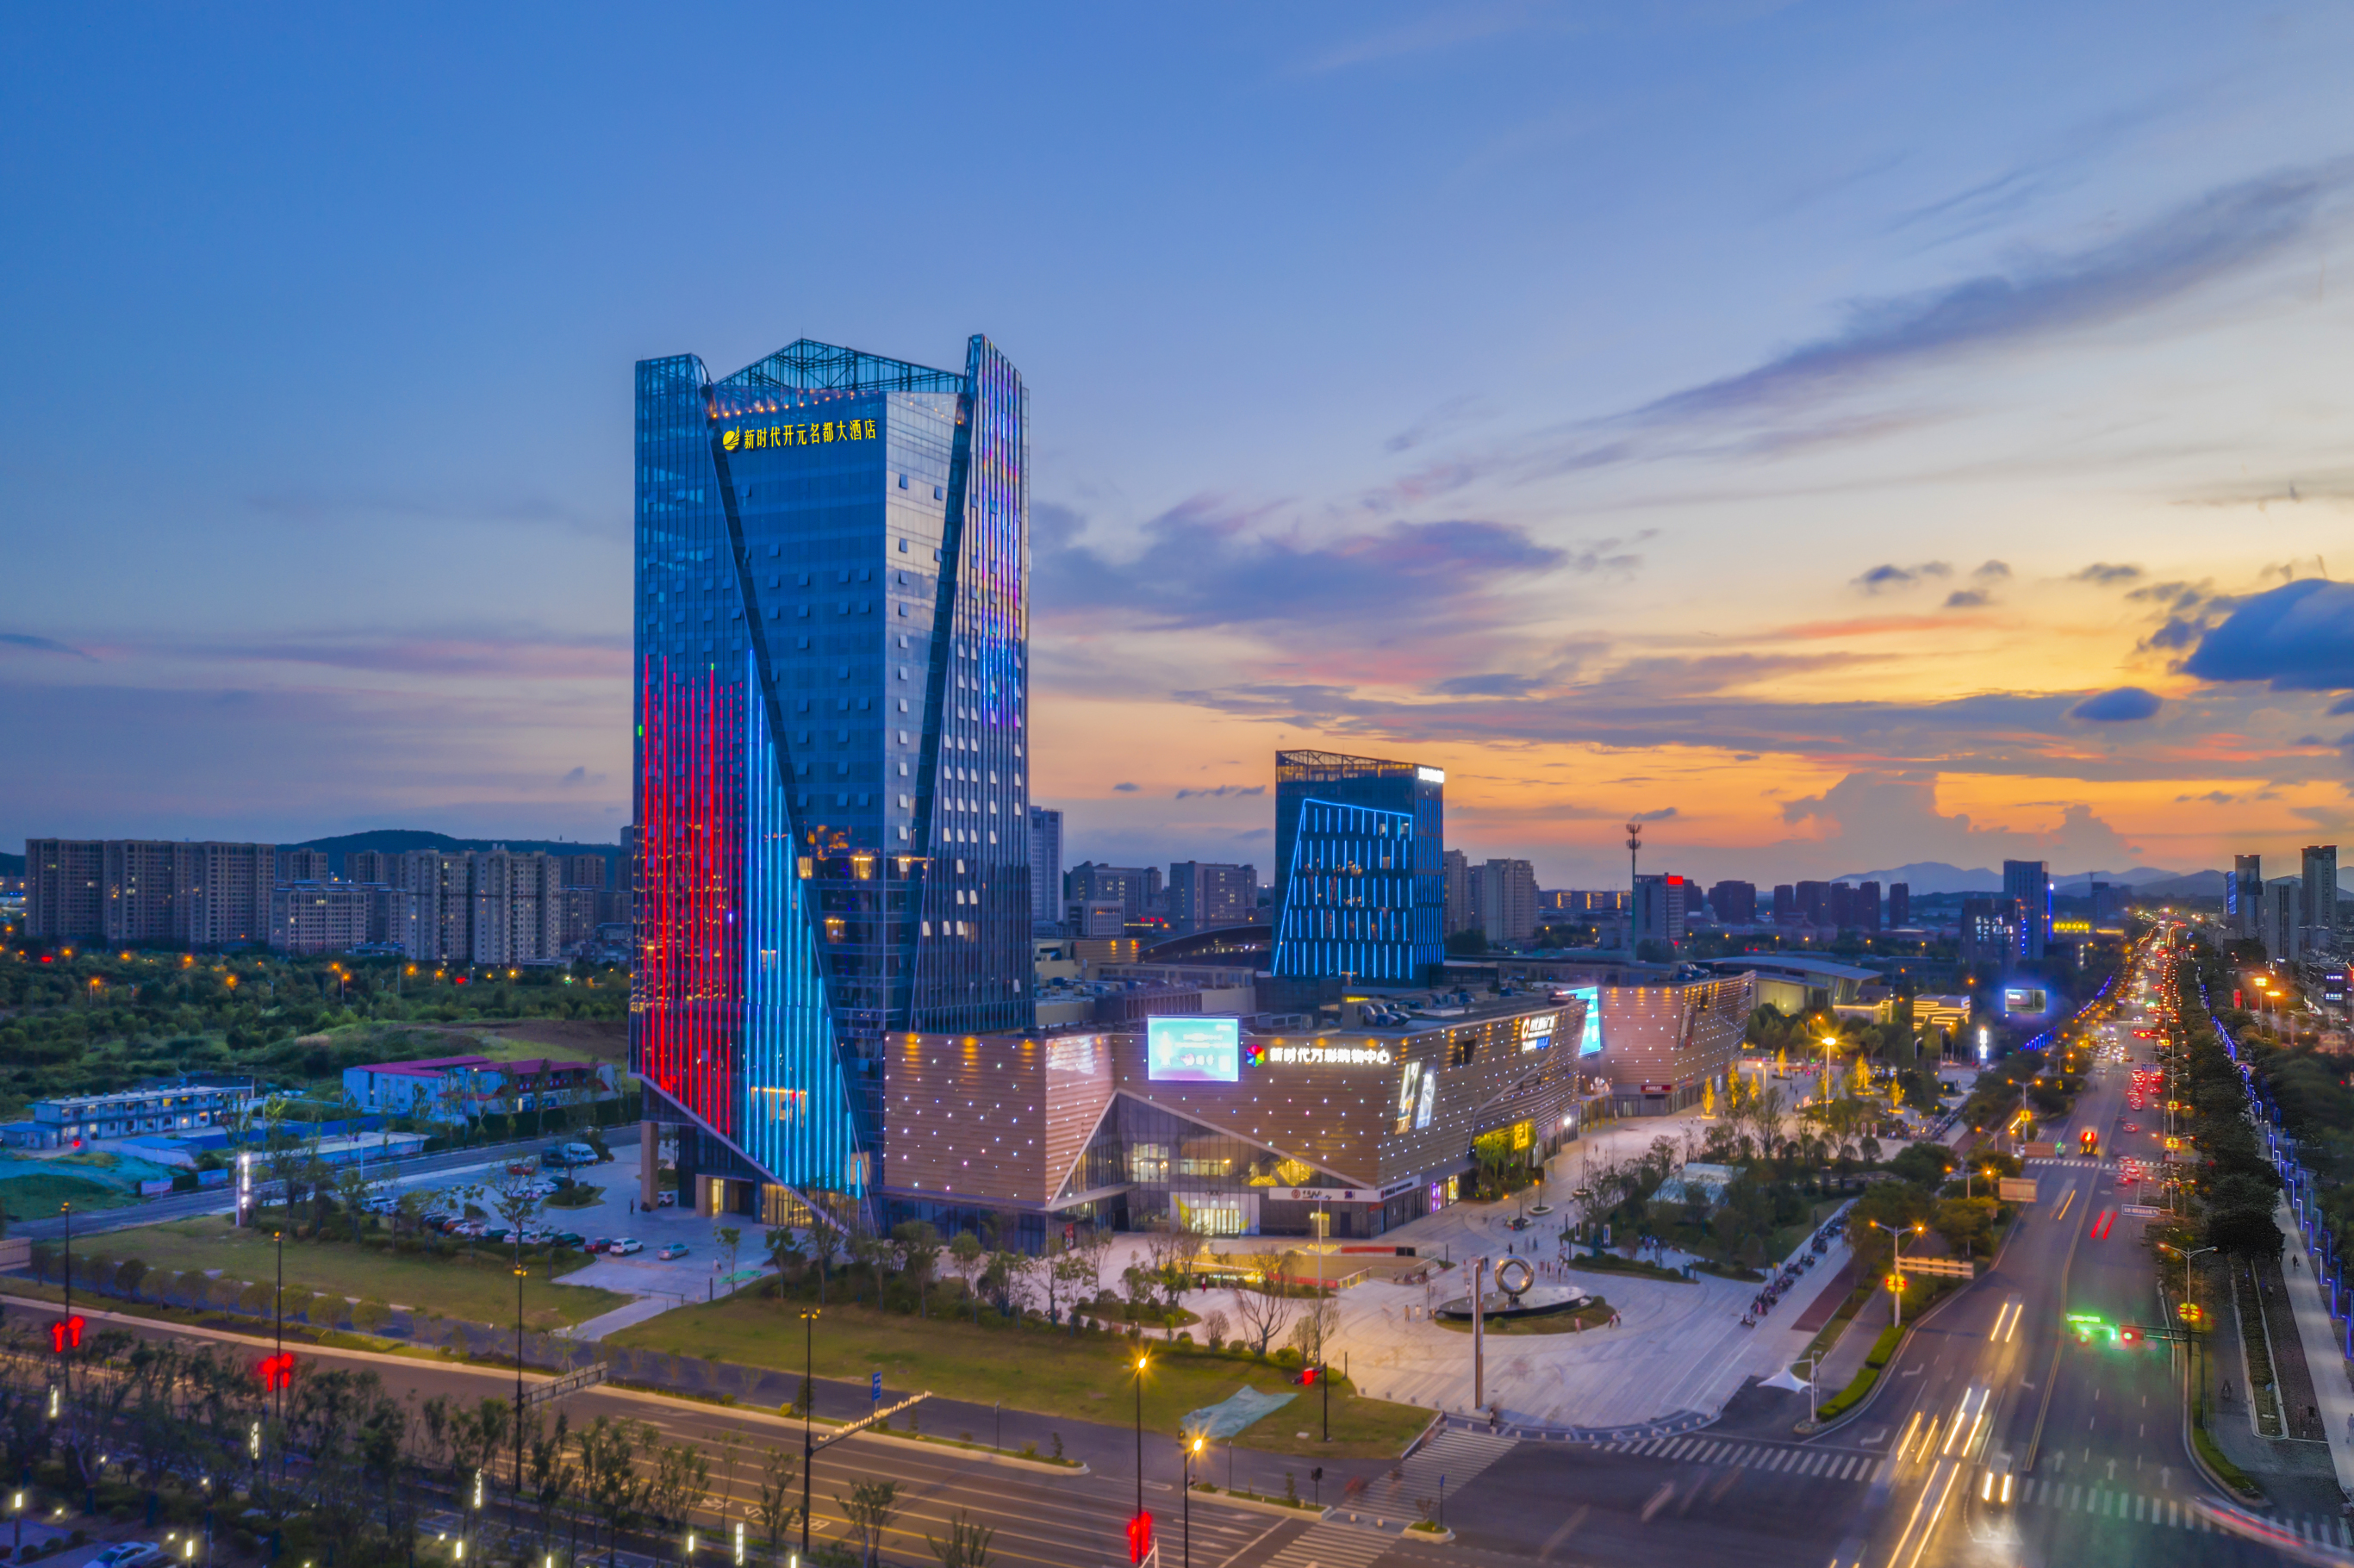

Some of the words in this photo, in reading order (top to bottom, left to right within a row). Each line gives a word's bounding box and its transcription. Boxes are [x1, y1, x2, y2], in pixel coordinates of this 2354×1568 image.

[744, 419, 876, 450] 新时代开元名都大酒店
